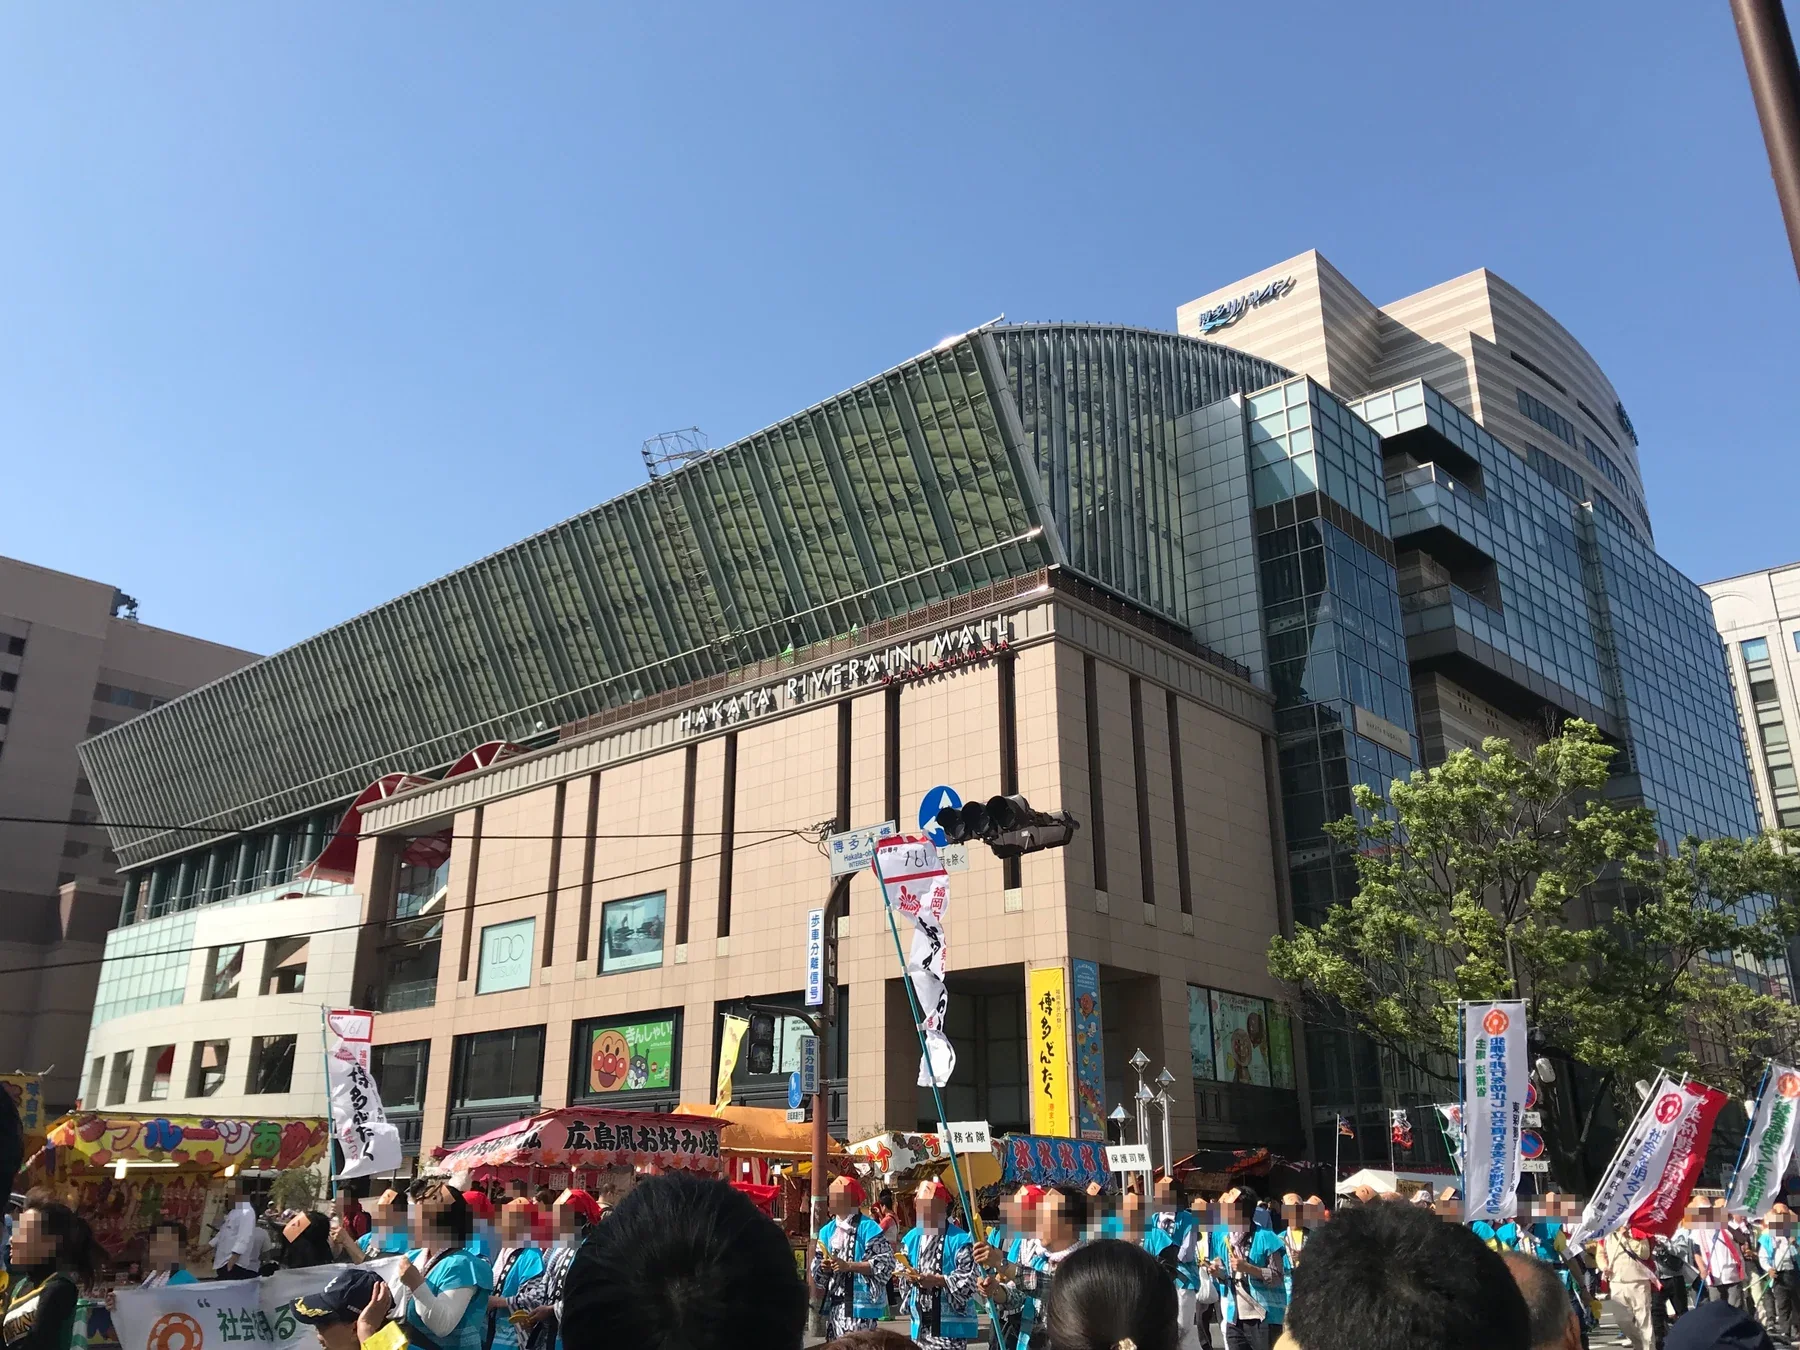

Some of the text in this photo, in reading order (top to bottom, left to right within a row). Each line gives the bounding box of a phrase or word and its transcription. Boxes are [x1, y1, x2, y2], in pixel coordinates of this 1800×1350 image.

[679, 613, 1009, 732] HAKATA RIVERAIN MALL
[898, 640, 1009, 682] TAKASHIMAYA
[809, 914, 820, 1000] 歩車分離信号
[804, 1038, 815, 1092] 歩車分離信号
[1038, 990, 1056, 1100] 博多どんたく
[106, 1116, 314, 1162] フルーツあめ
[563, 1120, 719, 1158] 広島風お好み焼
[1110, 1152, 1147, 1165] 保護司隊
